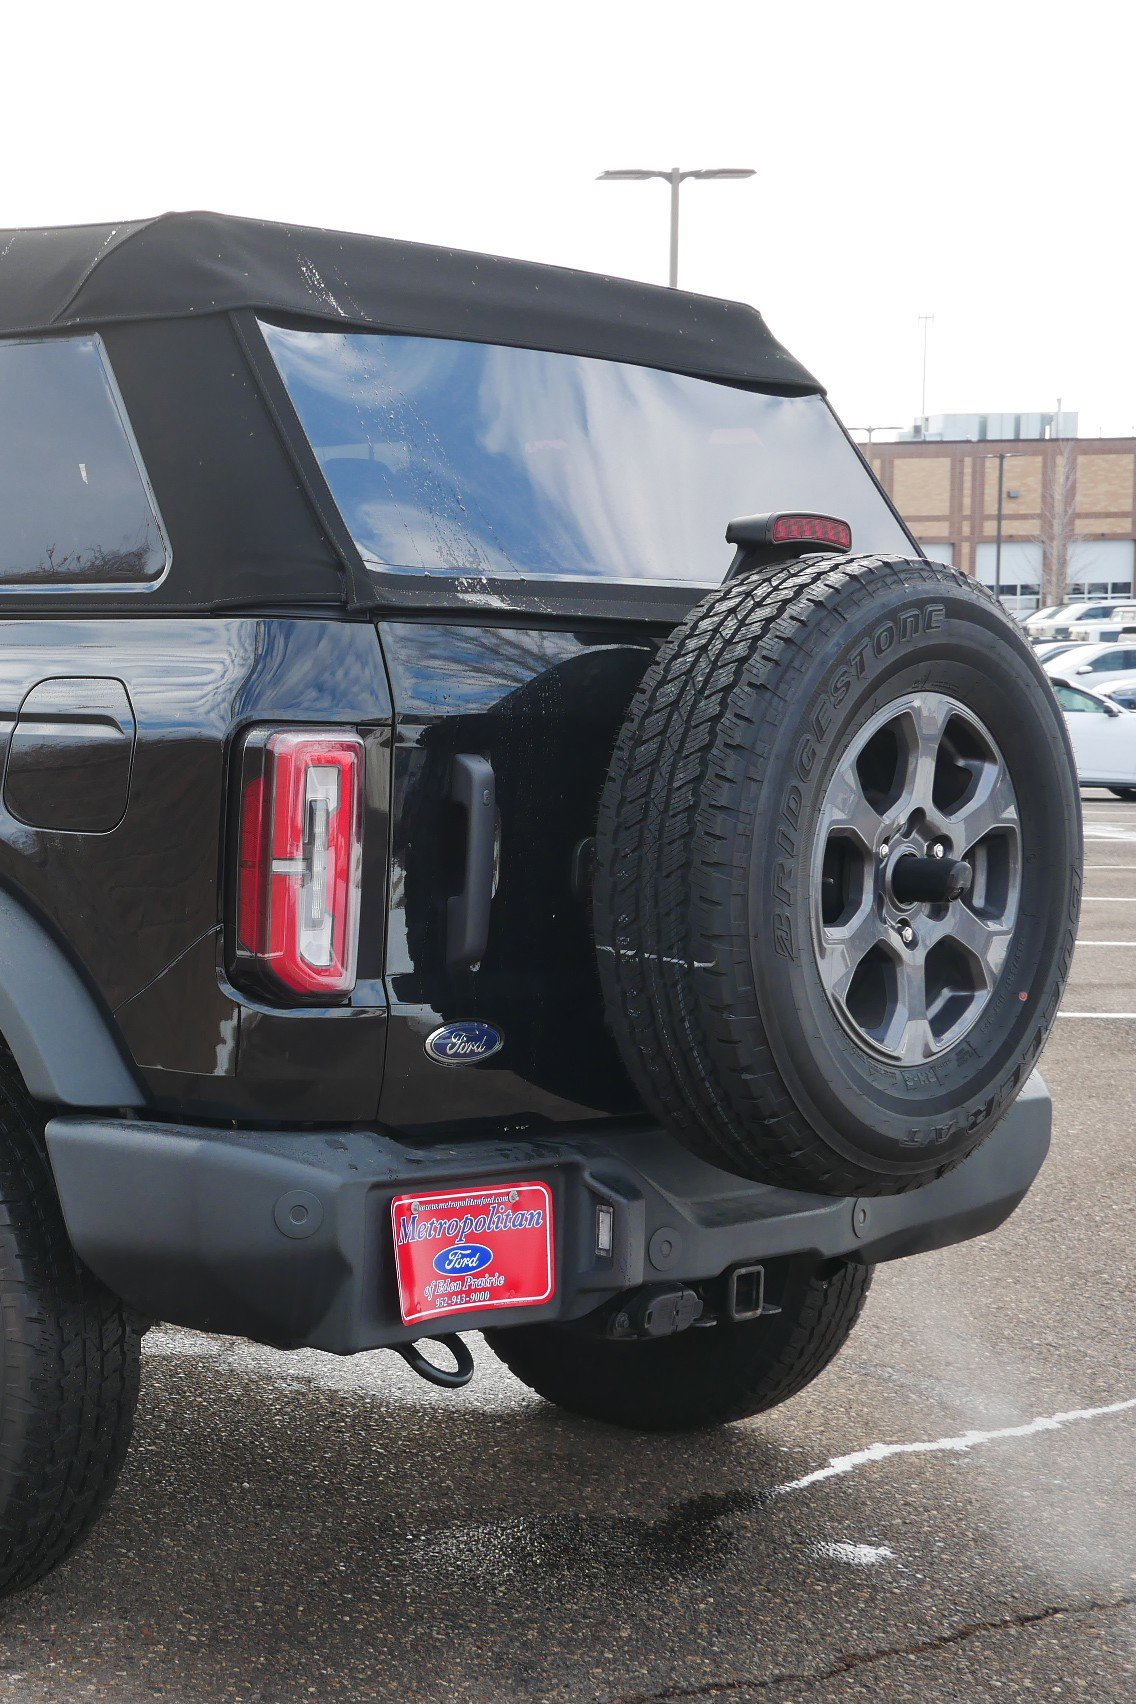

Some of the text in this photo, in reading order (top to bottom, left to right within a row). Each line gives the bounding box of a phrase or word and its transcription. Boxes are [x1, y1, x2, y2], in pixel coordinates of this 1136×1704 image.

[770, 603, 949, 961] BRIDGESTONE
[445, 1030, 489, 1056] Ford
[418, 1195, 509, 1212] www.metropolitanford.com
[398, 1204, 544, 1245] Metropolitan
[445, 1249, 479, 1270] Ford
[424, 1273, 505, 1300] of Eden Prairie
[435, 1291, 490, 1308] 952-943-9000
